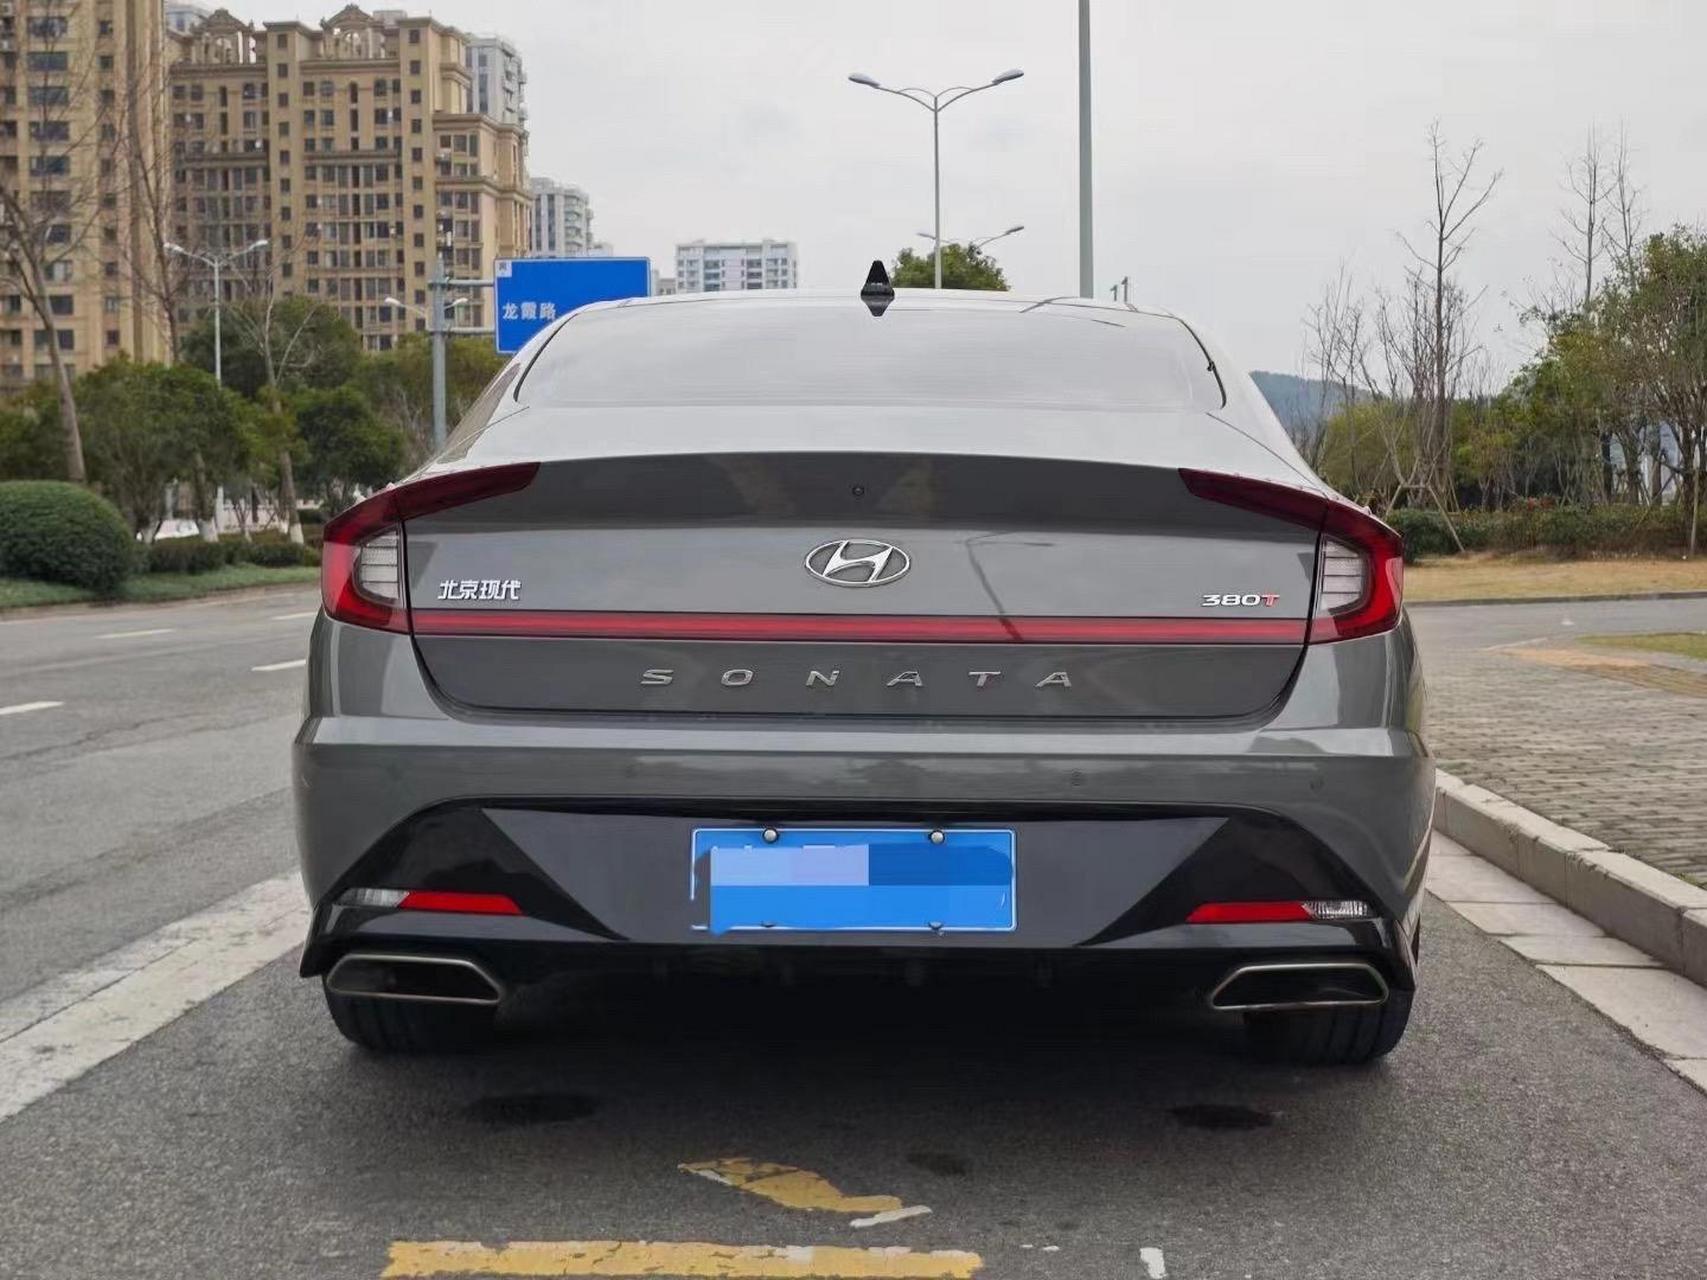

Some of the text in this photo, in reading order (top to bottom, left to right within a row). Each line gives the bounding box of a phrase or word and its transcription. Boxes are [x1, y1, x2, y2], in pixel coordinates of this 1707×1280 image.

[437, 579, 521, 600] 北京现代
[1202, 594, 1280, 606] 380T
[640, 668, 1072, 689] SONATA
